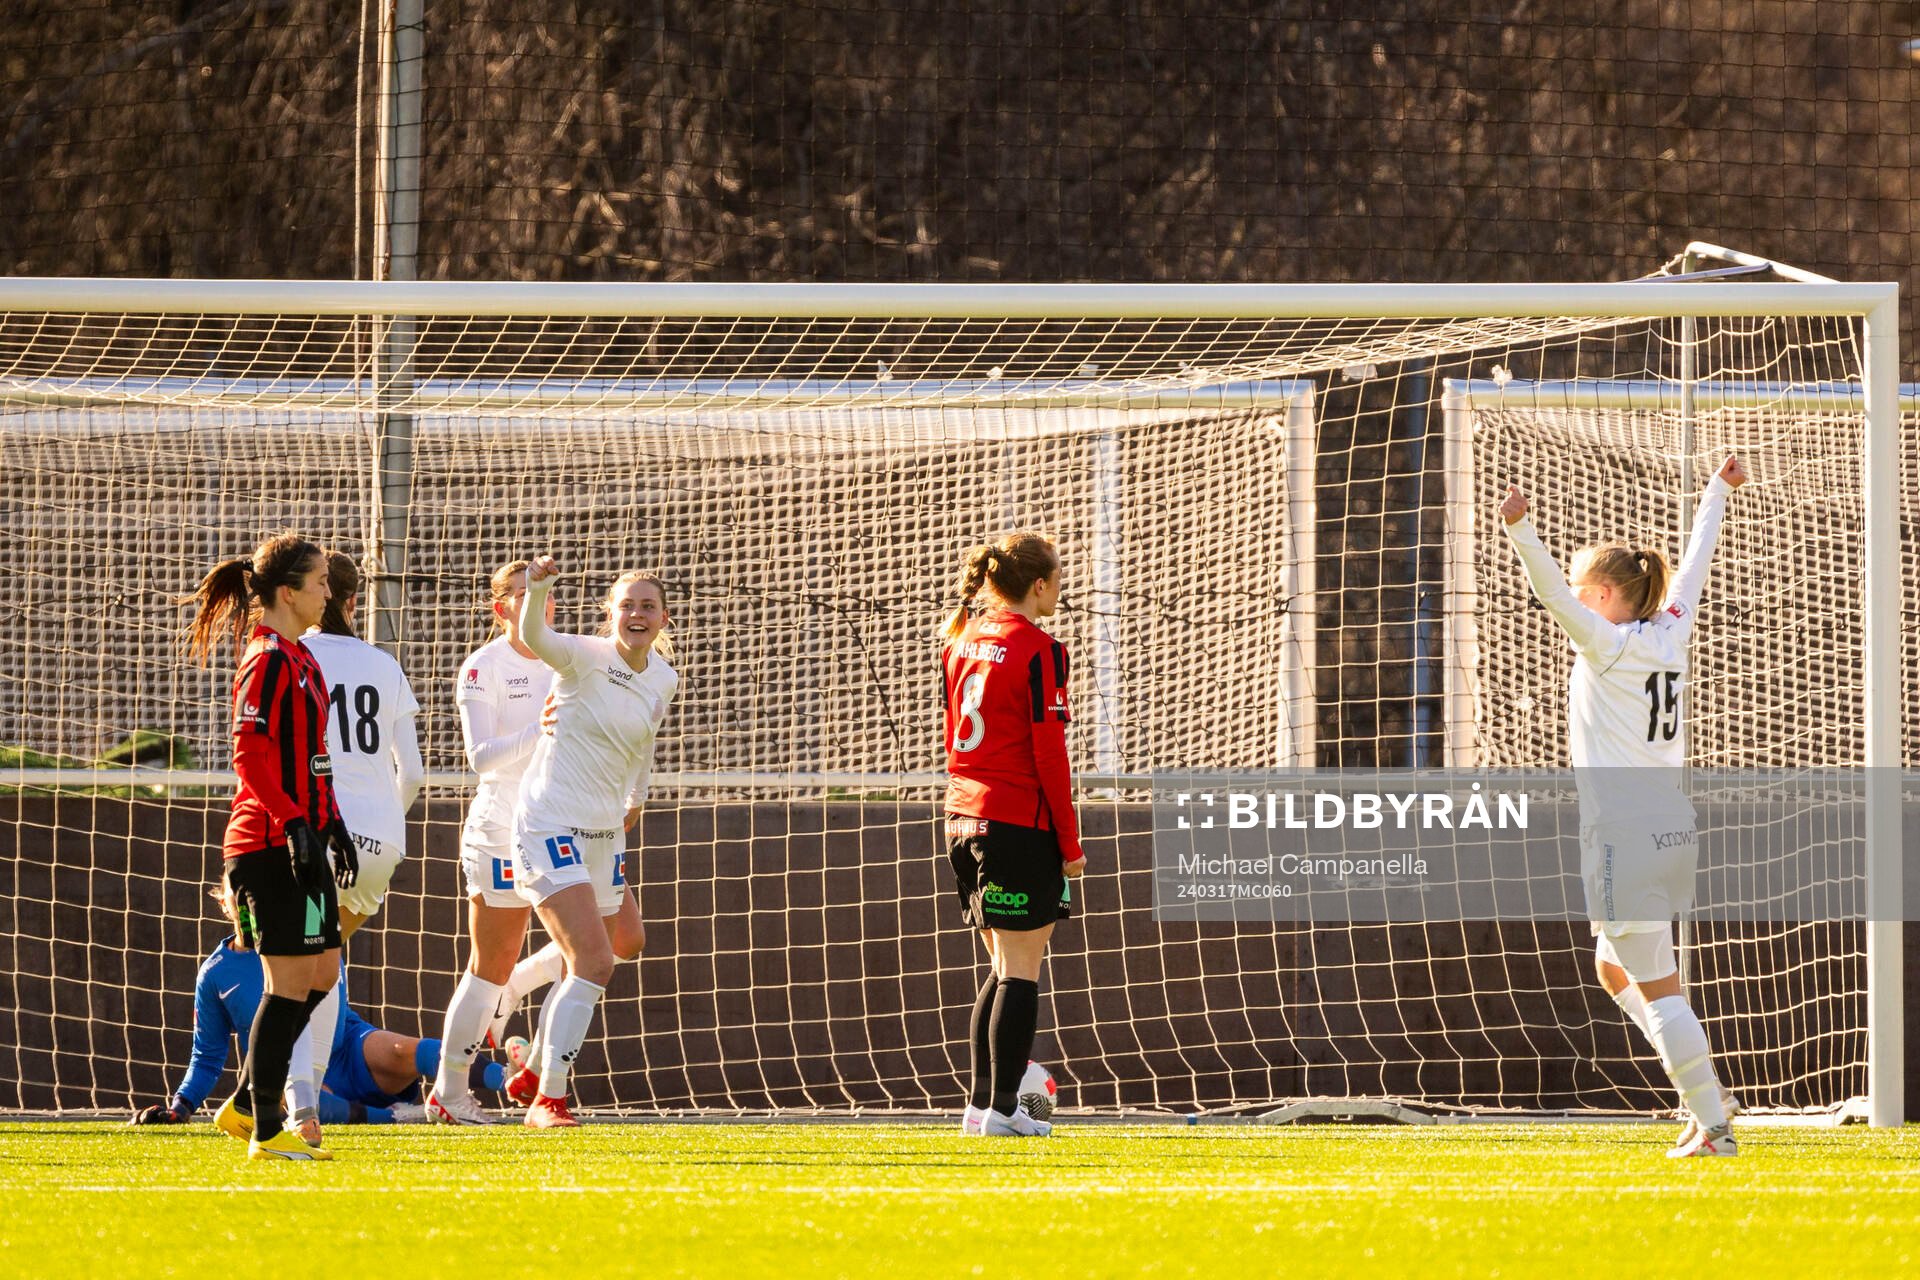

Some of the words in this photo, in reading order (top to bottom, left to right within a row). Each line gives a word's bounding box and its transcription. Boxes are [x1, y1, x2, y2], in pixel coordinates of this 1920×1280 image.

[607, 664, 634, 681] brand
[1645, 671, 1682, 742] 15
[330, 683, 380, 755] 18
[953, 672, 986, 753] 8
[984, 891, 1029, 908] coop
